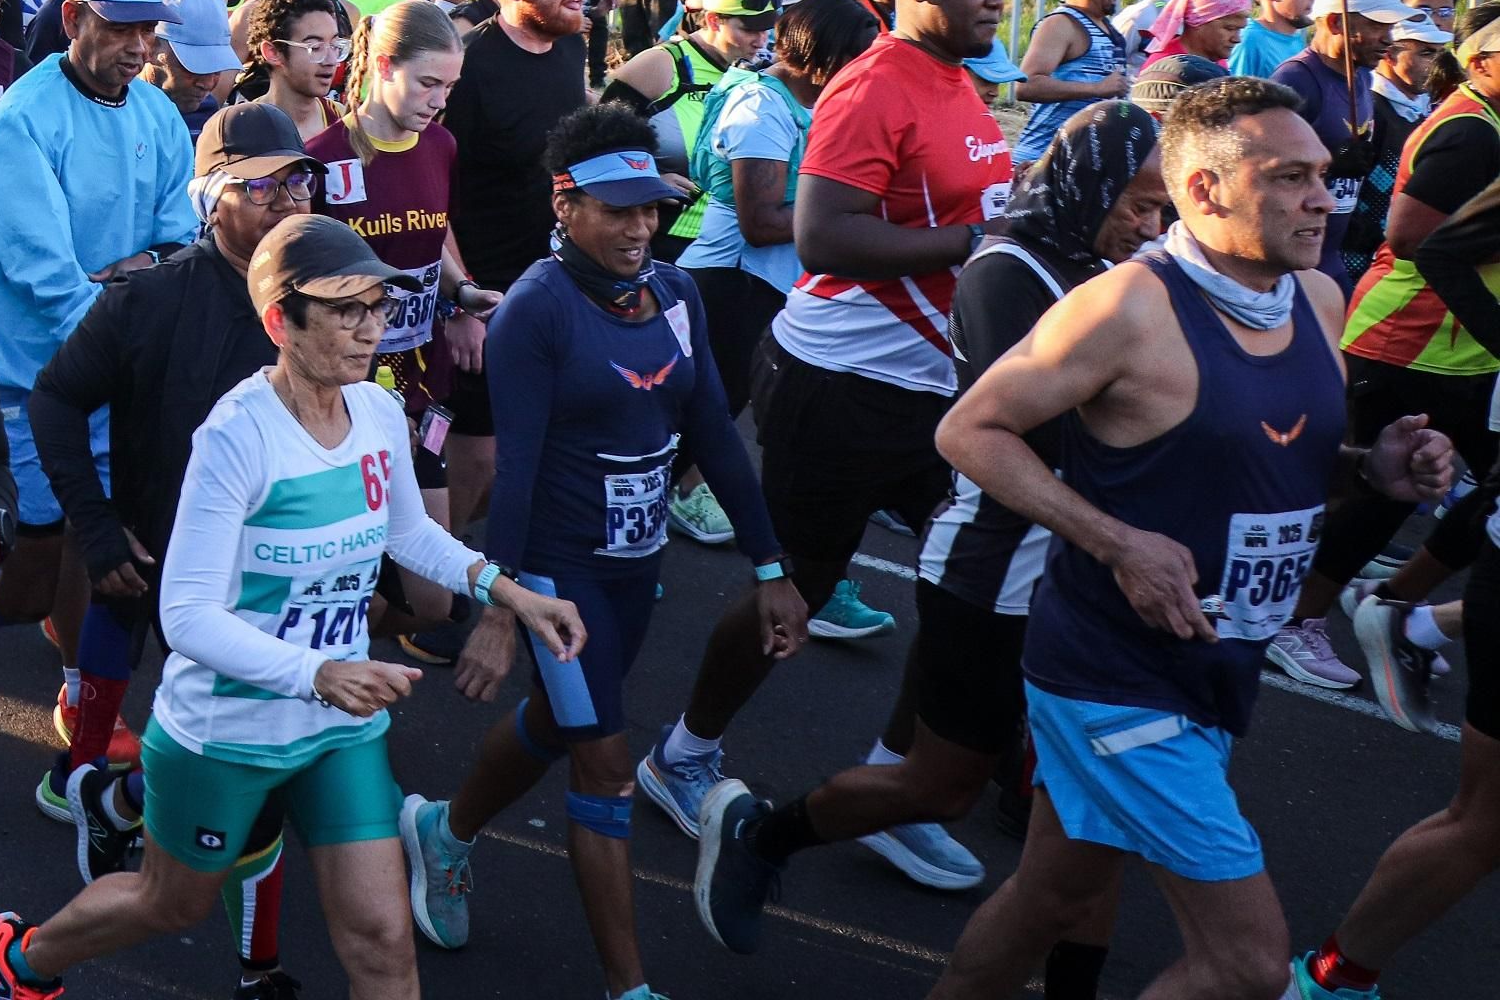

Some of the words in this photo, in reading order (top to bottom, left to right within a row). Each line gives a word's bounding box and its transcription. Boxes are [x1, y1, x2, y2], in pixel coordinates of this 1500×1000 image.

[331, 162, 353, 201] J
[348, 214, 403, 238] Kuils
[407, 208, 449, 232] River
[360, 449, 393, 512] 65
[254, 540, 337, 565] CELTIC
